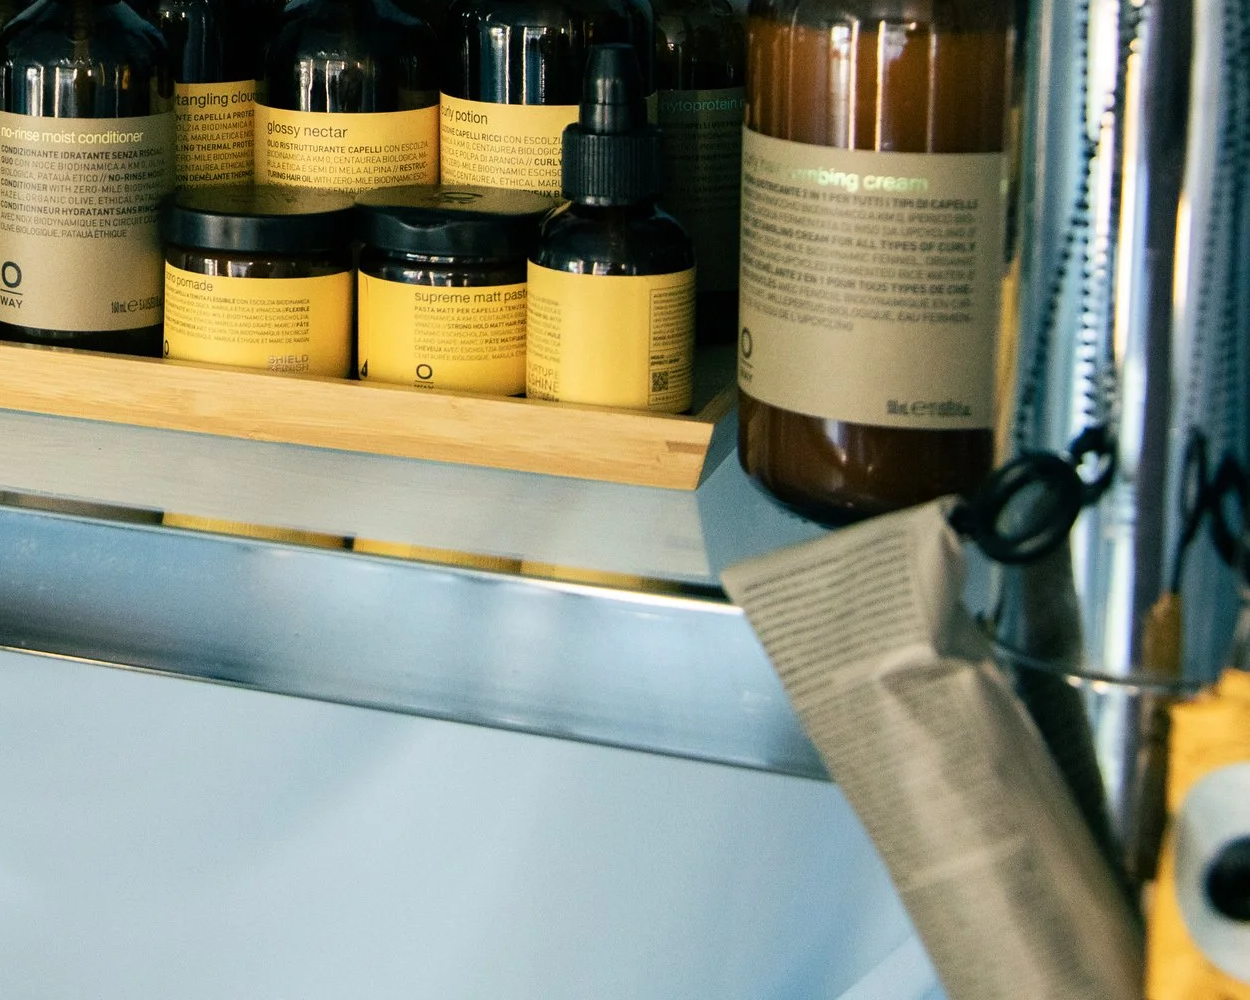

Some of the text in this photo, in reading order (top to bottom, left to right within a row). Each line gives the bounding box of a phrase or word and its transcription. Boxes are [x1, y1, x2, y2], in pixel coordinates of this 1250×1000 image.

[176, 92, 228, 108] tangling
[456, 110, 488, 124] potion
[268, 120, 348, 138] glossy nectar
[0, 127, 144, 144] no-rinse moist conditioner
[482, 133, 502, 142] RICCI
[504, 135, 522, 144] CON
[0, 144, 138, 160] CONDIZIONANTE IDRATANTE SENZA
[196, 142, 232, 151] THERMAL
[280, 142, 346, 154] RISTRUTTURANTE
[384, 144, 400, 152] CON
[14, 158, 30, 168] CON
[32, 161, 56, 170] NOCE
[58, 162, 119, 171] BIODINAMICA
[334, 156, 381, 164] CENTAUREA
[339, 166, 362, 174] MELA
[363, 166, 392, 174] ALPINA
[478, 164, 526, 176] BIODYNAMIC
[108, 171, 146, 182] NO-RINSE
[286, 172, 302, 182] HAIR
[302, 175, 313, 183] OIL
[314, 176, 332, 184] WITH
[500, 177, 536, 187] ETHICAL
[0, 178, 122, 194] CONDITIONER WITH ZERO-MILE
[26, 194, 67, 204] ORGANIC
[98, 196, 132, 205] ETHICAL
[0, 200, 138, 216] CONDITIONNEUR HYDRATANT SANS
[34, 216, 98, 228] BIODYNAMIQUE
[100, 219, 111, 228] EN
[2, 261, 22, 288] O
[176, 276, 214, 292] pomade
[0, 295, 23, 308] WAY
[414, 292, 470, 304] supreme
[474, 292, 501, 302] matt
[416, 364, 432, 380] O
